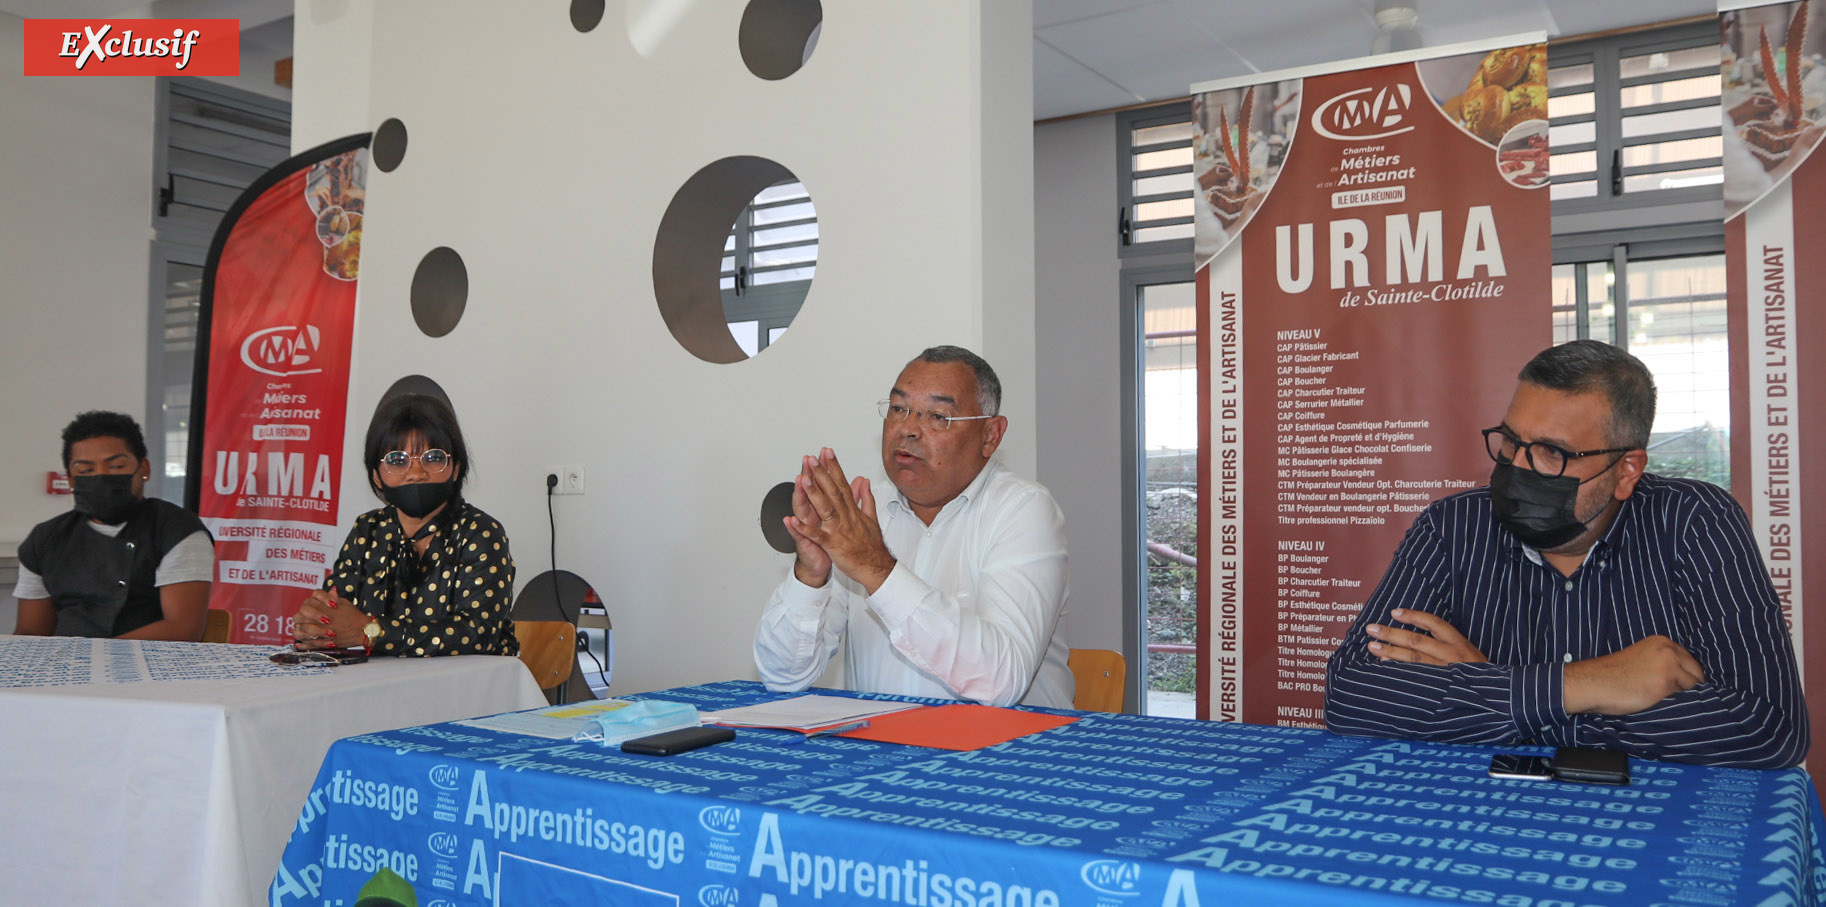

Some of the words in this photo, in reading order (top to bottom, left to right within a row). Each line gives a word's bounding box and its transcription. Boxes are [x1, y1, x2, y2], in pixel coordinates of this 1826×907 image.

[1343, 145, 1385, 155] Chambres
[1340, 153, 1401, 171] Métiers
[1338, 196, 1348, 205] ILE
[1350, 195, 1359, 203] DE
[1361, 193, 1369, 202] LA
[1371, 189, 1403, 201] RÉUNION
[1275, 205, 1507, 294] URMA
[1339, 291, 1360, 308] de
[1364, 280, 1505, 307] Sainte-Clotilde
[1763, 245, 1787, 367] L'ARTISANAT
[1277, 329, 1312, 341] NIVEAU
[1314, 328, 1321, 339] V
[1221, 291, 1237, 394] L'ARTISANAT
[1277, 343, 1293, 352] CAP
[1294, 341, 1328, 351] Pâtissier
[1277, 355, 1293, 363] CAP
[1295, 353, 1321, 363] Glacier
[1323, 351, 1359, 361] Fabricant
[1277, 366, 1293, 375] CAP
[1295, 365, 1333, 376] Boulanger
[1277, 378, 1293, 386] CAP
[1295, 376, 1327, 386] Boucher
[1767, 372, 1788, 397] DE
[1277, 389, 1293, 397] CAP
[1295, 388, 1334, 397] Charcutier
[1336, 386, 1365, 396] Traiteur
[1222, 398, 1237, 420] DE
[1277, 400, 1293, 409] CAP
[1295, 399, 1328, 409] Serrurier
[1330, 398, 1364, 407] Métallier
[1277, 412, 1293, 420] CAP
[1295, 411, 1325, 420] Coiffure
[1767, 404, 1788, 426] ET
[1277, 424, 1293, 432] CAP
[1295, 422, 1335, 433] Esthétique
[1336, 420, 1382, 431] Cosmétique
[1384, 420, 1429, 429] Parfumerie
[1222, 425, 1237, 444] ET
[1277, 435, 1293, 443] CAP
[1295, 434, 1316, 445] Agent
[1319, 433, 1328, 443] de
[1330, 432, 1363, 444] Propreté
[1365, 433, 1372, 441] et
[1374, 432, 1414, 443] d'Hygiène
[1278, 447, 1290, 455] MC
[1292, 445, 1329, 455] Pâtisserie
[1331, 445, 1353, 454] Glace
[1354, 444, 1389, 453] Chocolat
[1391, 443, 1432, 453] Confiserie
[1278, 458, 1290, 466] MC
[1292, 457, 1337, 468] Boulangerie
[1339, 456, 1382, 467] spécialisée
[1278, 470, 1290, 478] MC
[1292, 468, 1329, 478] Pâtisserie
[1331, 468, 1375, 479] Boulangère
[1764, 432, 1790, 517] MÉTIERS
[1219, 448, 1237, 519] MÉTIERS
[1278, 481, 1295, 489] CTM
[1297, 480, 1341, 491] Préparateur
[1343, 480, 1375, 489] Vendeur
[1377, 480, 1393, 491] Opt.
[1394, 479, 1442, 489] Charcuterie
[1444, 479, 1476, 488] Traiteur
[1278, 493, 1295, 501] CTM
[1296, 492, 1328, 501] Vendeur
[1341, 491, 1387, 502] Boulangerie
[1389, 491, 1430, 500] Pâtisserie
[248, 497, 330, 512] SAINTE-CLOTILDE
[1278, 504, 1295, 512] CTM
[1297, 503, 1341, 514] Préparateur
[1343, 503, 1375, 512] vendeur
[1377, 504, 1392, 514] opt.
[1278, 516, 1296, 525] Titre
[1297, 516, 1348, 526] professionnel
[1350, 516, 1385, 525] Pizzaïolo
[269, 526, 322, 542] RÉGIONALE
[1221, 525, 1237, 556] DES
[1278, 541, 1313, 551] NIVEAU
[1316, 541, 1325, 551] IV
[1769, 523, 1791, 561] DES
[265, 548, 287, 558] DES
[290, 547, 326, 563] MÉTIERS
[1278, 554, 1288, 562] BP
[1290, 554, 1329, 564] Boulanger
[228, 568, 240, 579] ET
[241, 569, 256, 580] DE
[258, 569, 319, 585] L'ARTISANAT
[1278, 566, 1288, 574] BP
[1290, 566, 1322, 574] Boucher
[1278, 577, 1288, 585] BP
[1290, 577, 1330, 587] Charcutier
[1331, 578, 1361, 588] Traiteur
[1278, 589, 1288, 597] BP
[1290, 589, 1320, 598] Coiffure
[1218, 561, 1237, 652] RÉGIONALE
[1278, 600, 1288, 608] BP
[1290, 600, 1330, 611] Esthétique
[244, 613, 268, 633] 28
[1278, 612, 1288, 620] BP
[1290, 612, 1334, 622] Préparateur
[1278, 623, 1288, 632] BP
[1290, 623, 1323, 633] Métallier
[1278, 635, 1295, 644] BTM
[1278, 646, 1294, 655] Titre
[1278, 658, 1295, 667] Titre
[1278, 669, 1295, 678] Titre
[1277, 681, 1294, 690] BAC
[1295, 682, 1311, 691] PRO
[1277, 706, 1312, 718] NIVEAU
[936, 750, 1213, 786] Apprentissage
[895, 759, 1185, 800] Apprentissage
[855, 770, 1155, 813] Apprentissage
[1311, 772, 1664, 815] Apprentissage
[810, 782, 1119, 829] Apprentissage
[1288, 785, 1656, 831] Apprentissage
[464, 769, 685, 870] Apprentissage
[762, 794, 1082, 847] Apprentissage
[1261, 799, 1648, 850] Apprentissage
[1231, 812, 1638, 870] Apprentissage
[1200, 829, 1627, 893] Apprentissage
